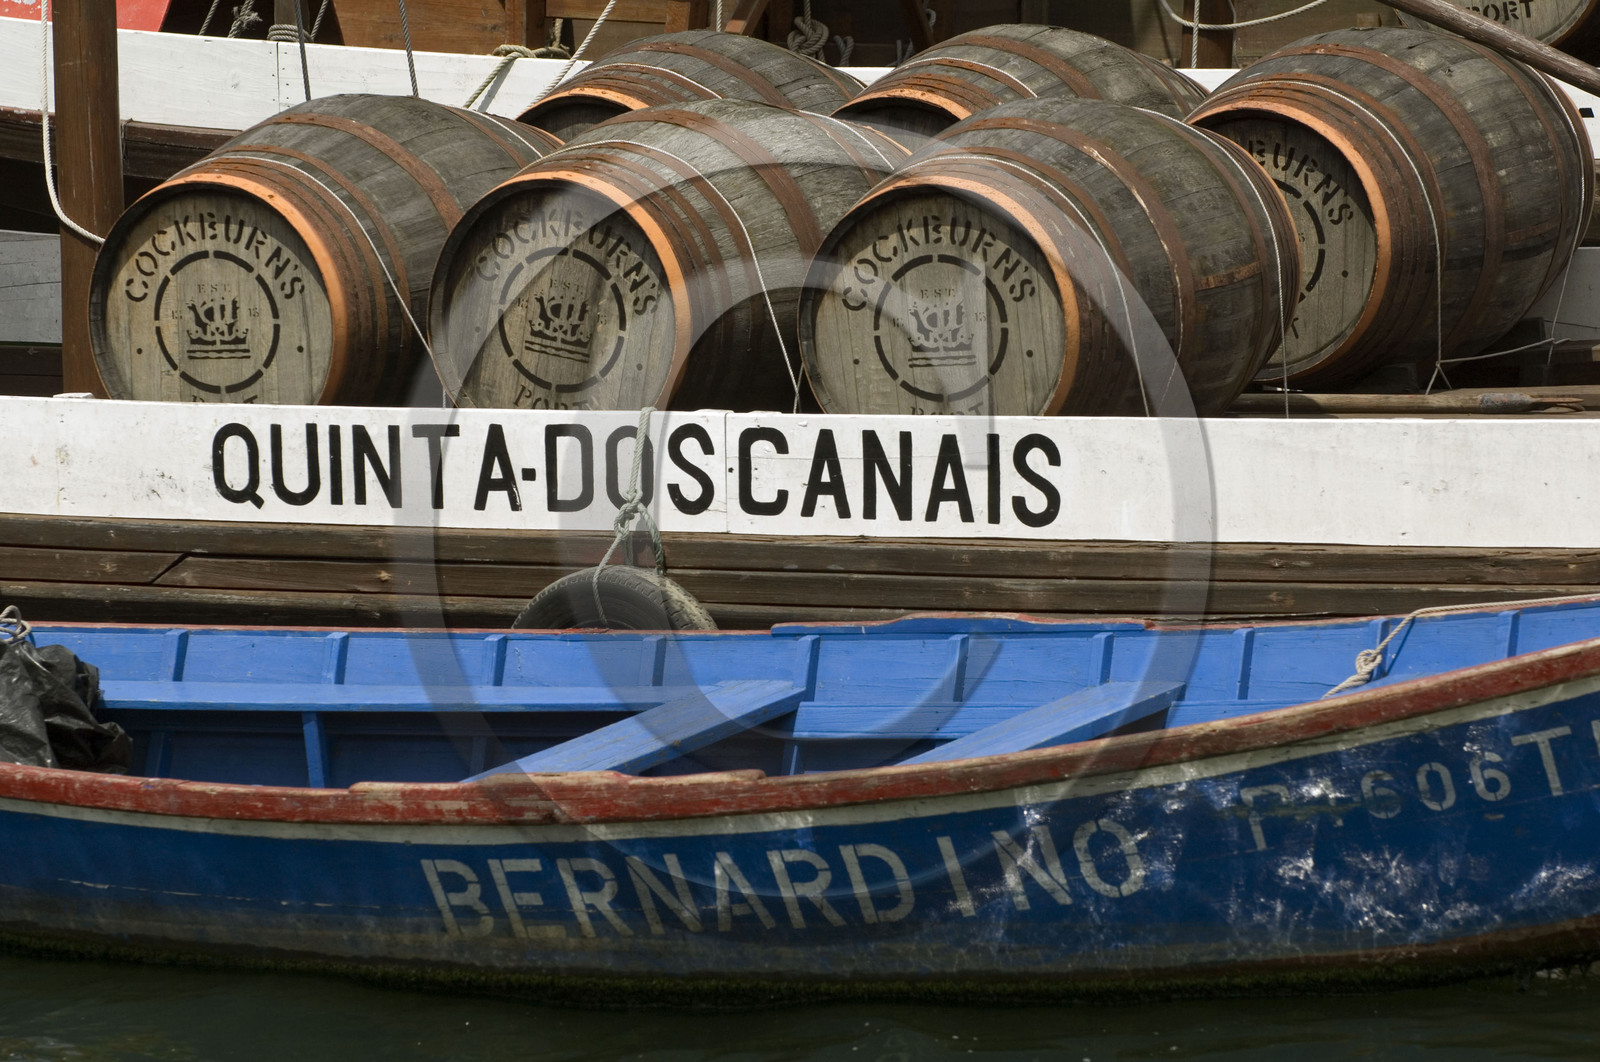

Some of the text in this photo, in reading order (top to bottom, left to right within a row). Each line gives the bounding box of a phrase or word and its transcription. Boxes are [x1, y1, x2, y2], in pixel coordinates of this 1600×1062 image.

[125, 212, 305, 302] COCKBURN'S
[475, 209, 658, 316] COCKBURN'S
[842, 215, 1036, 311] COCKBURN'S
